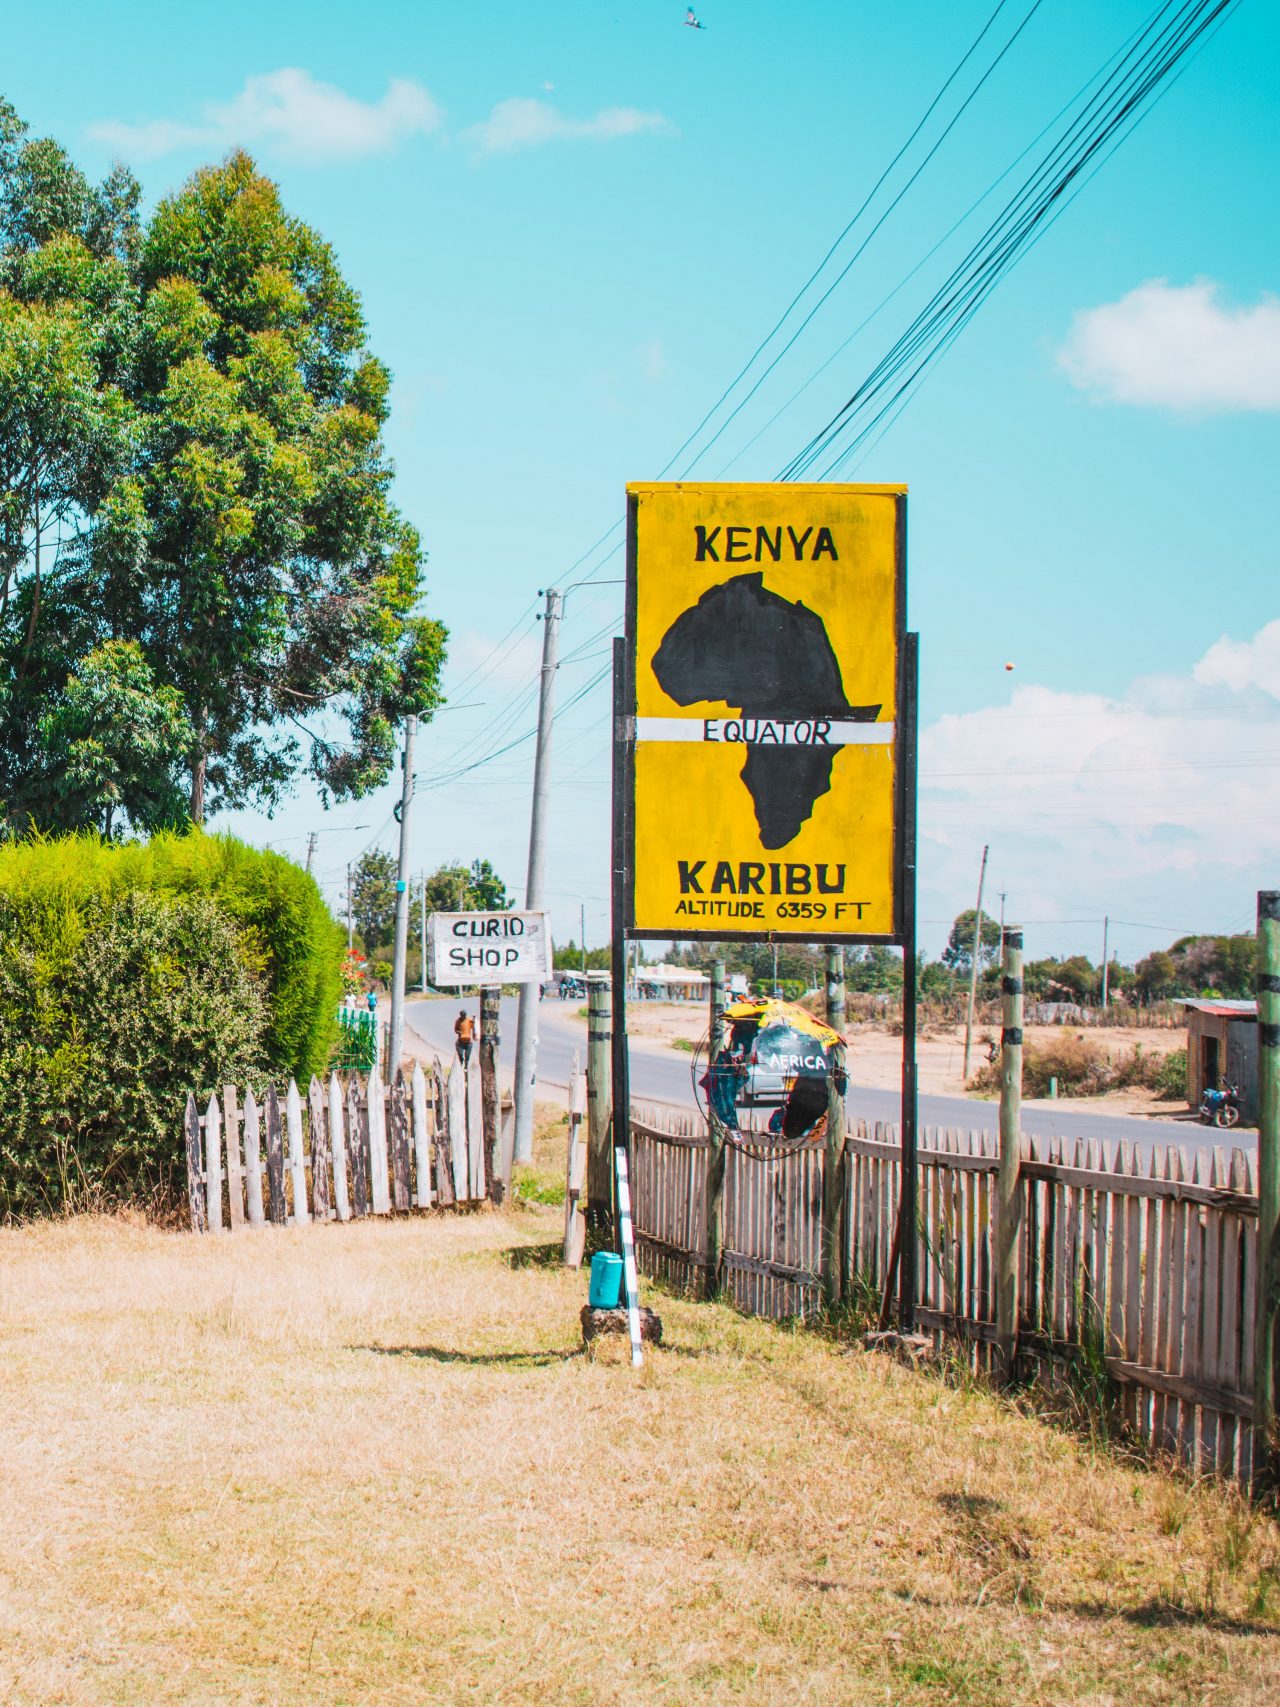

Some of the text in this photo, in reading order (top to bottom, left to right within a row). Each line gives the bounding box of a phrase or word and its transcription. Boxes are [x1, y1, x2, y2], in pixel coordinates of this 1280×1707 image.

[694, 525, 838, 562] KENYA
[703, 719, 832, 745] EQUATOR
[677, 861, 846, 895] KARIBU
[675, 900, 872, 920] ALTITUDE 6359 FT
[452, 916, 524, 937] CURIO
[449, 947, 519, 967] SHOP
